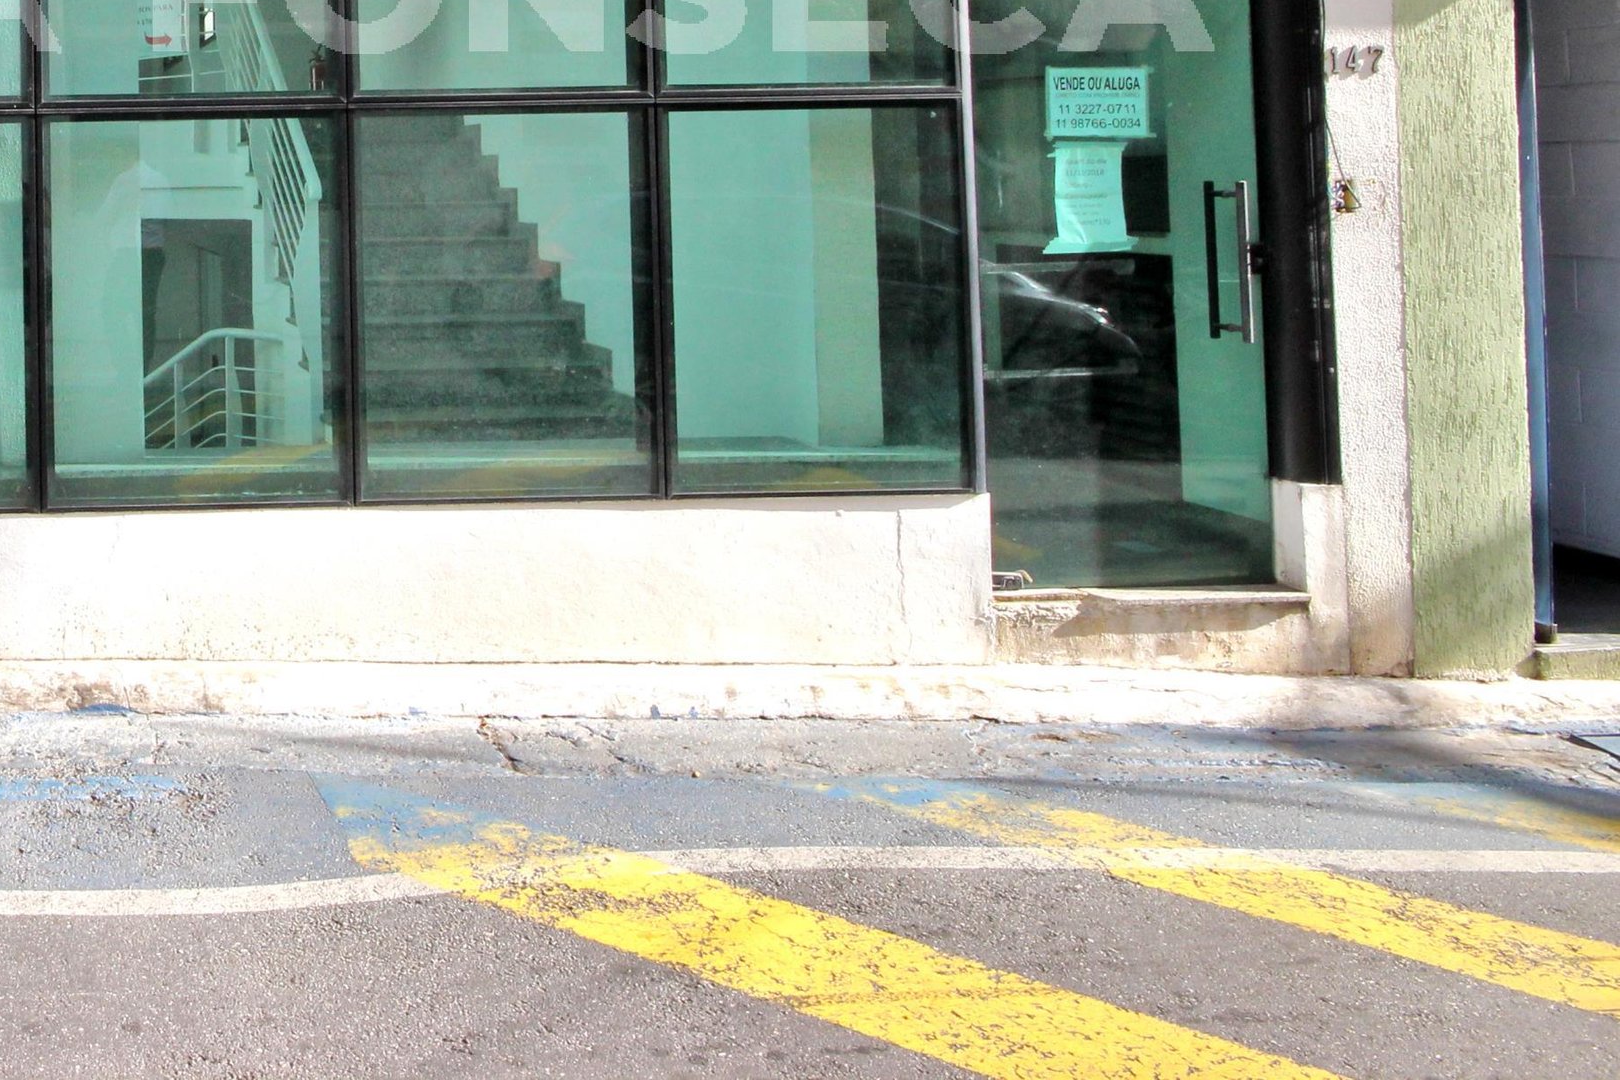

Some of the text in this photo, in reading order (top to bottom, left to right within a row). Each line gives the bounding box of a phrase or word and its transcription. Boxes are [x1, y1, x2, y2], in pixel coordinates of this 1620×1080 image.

[1330, 46, 1384, 74] 147
[1053, 76, 1140, 91] VENDE OU ALUGA
[1059, 104, 1136, 114] 11 3227-0711
[1057, 118, 1141, 129] 11 98766-0034
